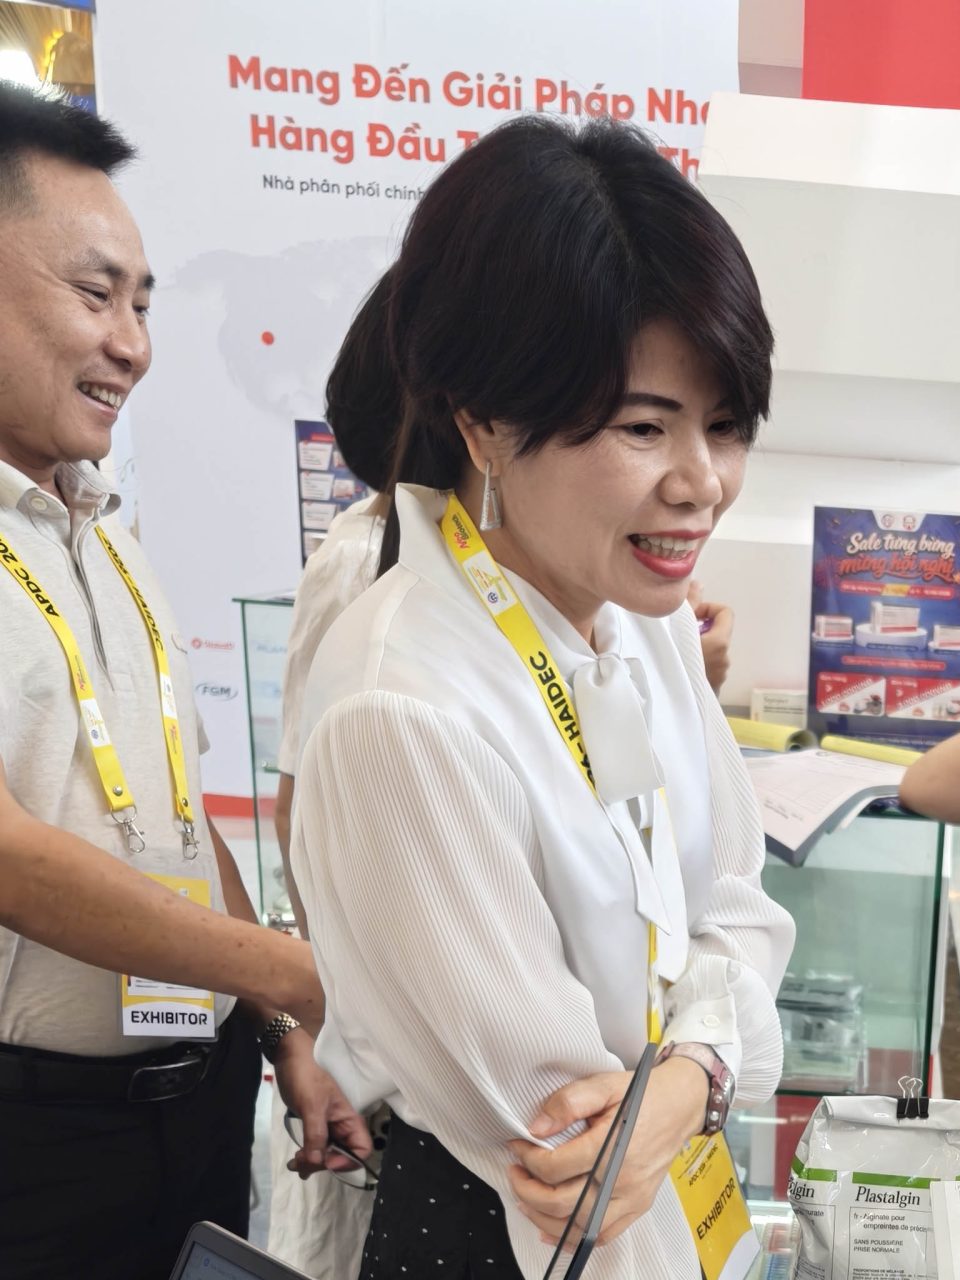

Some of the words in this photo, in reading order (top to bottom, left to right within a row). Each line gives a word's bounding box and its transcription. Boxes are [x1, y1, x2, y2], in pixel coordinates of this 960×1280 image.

[228, 54, 340, 105] Mang
[352, 63, 431, 103] Đến
[442, 71, 523, 110] Giải
[534, 78, 635, 121] Pháp
[250, 114, 354, 164] Hàng
[366, 122, 446, 162] Đầu
[262, 174, 295, 191] Nhà
[299, 179, 341, 196] phân
[345, 181, 381, 198] phối
[847, 532, 882, 553] Sale
[14, 567, 60, 618] APDC
[530, 651, 580, 741] HAIDEC
[131, 1010, 208, 1025] EXHIBITOR
[696, 1177, 736, 1240] EXHIBITOR
[855, 1186, 921, 1208] Plastalgin
[863, 1223, 899, 1231] empreintes
